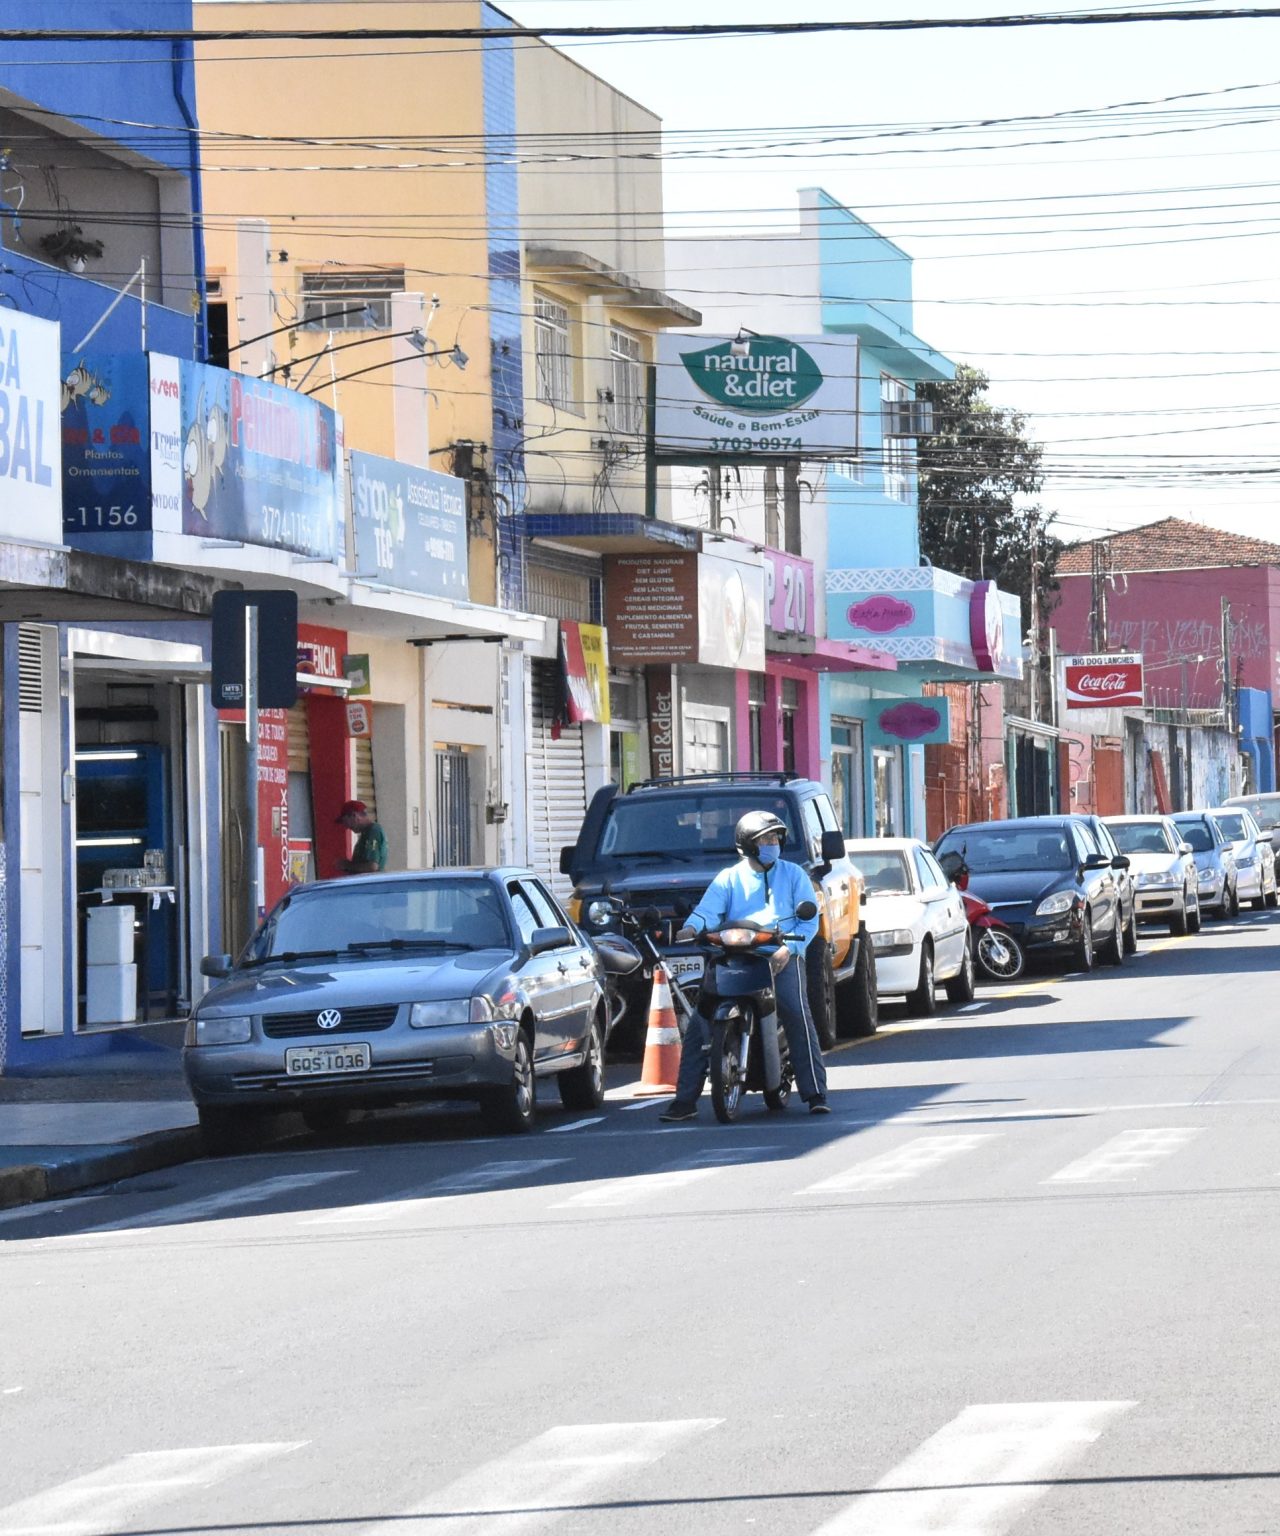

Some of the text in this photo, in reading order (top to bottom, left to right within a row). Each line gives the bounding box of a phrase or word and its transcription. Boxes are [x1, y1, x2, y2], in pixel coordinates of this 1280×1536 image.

[704, 348, 797, 373] natural
[724, 374, 797, 397] &diet
[692, 405, 820, 432] Saúde e Bem-Estar
[68, 466, 140, 477] Ornamentais
[783, 565, 806, 633] 20
[1078, 673, 1127, 690] Coca-Cola
[652, 692, 672, 745] &diet
[280, 788, 288, 882] XEROX
